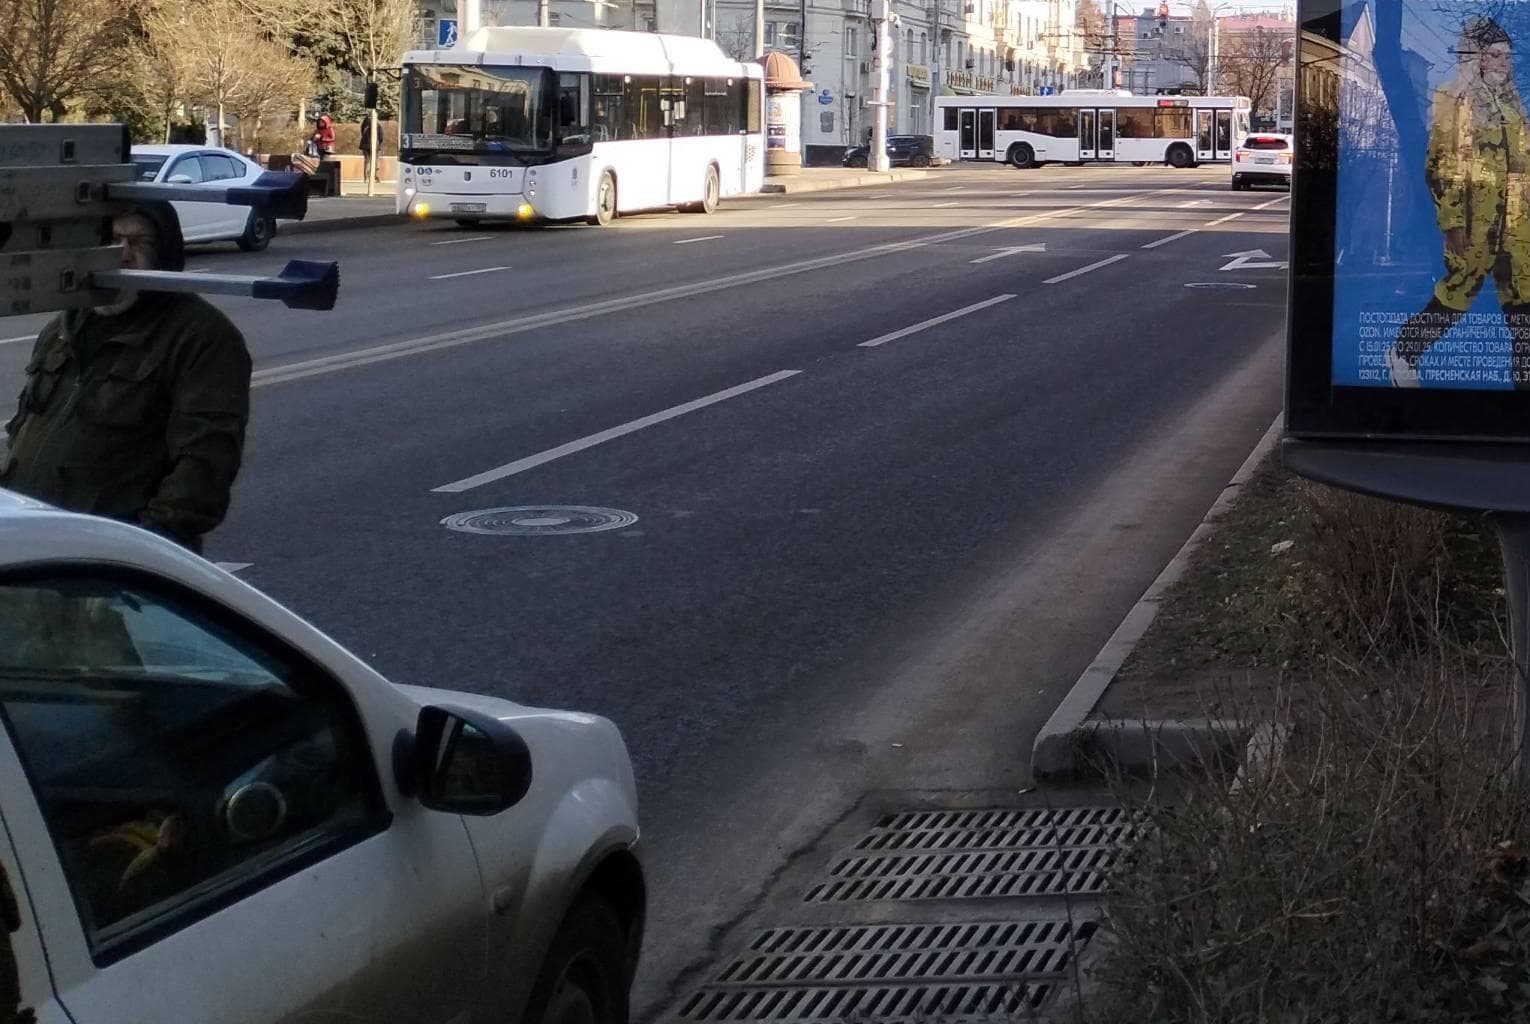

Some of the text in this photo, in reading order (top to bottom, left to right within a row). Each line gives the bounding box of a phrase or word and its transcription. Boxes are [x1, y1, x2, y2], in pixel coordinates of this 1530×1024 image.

[402, 135, 410, 149] 3
[489, 169, 513, 179] 6101
[1468, 313, 1502, 325] ТОВАРОВ
[1433, 342, 1484, 353] КОЛИЧЕСТВО
[1485, 342, 1513, 354] ТОВАРА
[1447, 356, 1471, 367] МЕСТЕ
[1425, 369, 1481, 382] ПРЕСНЕНСКАЯ
